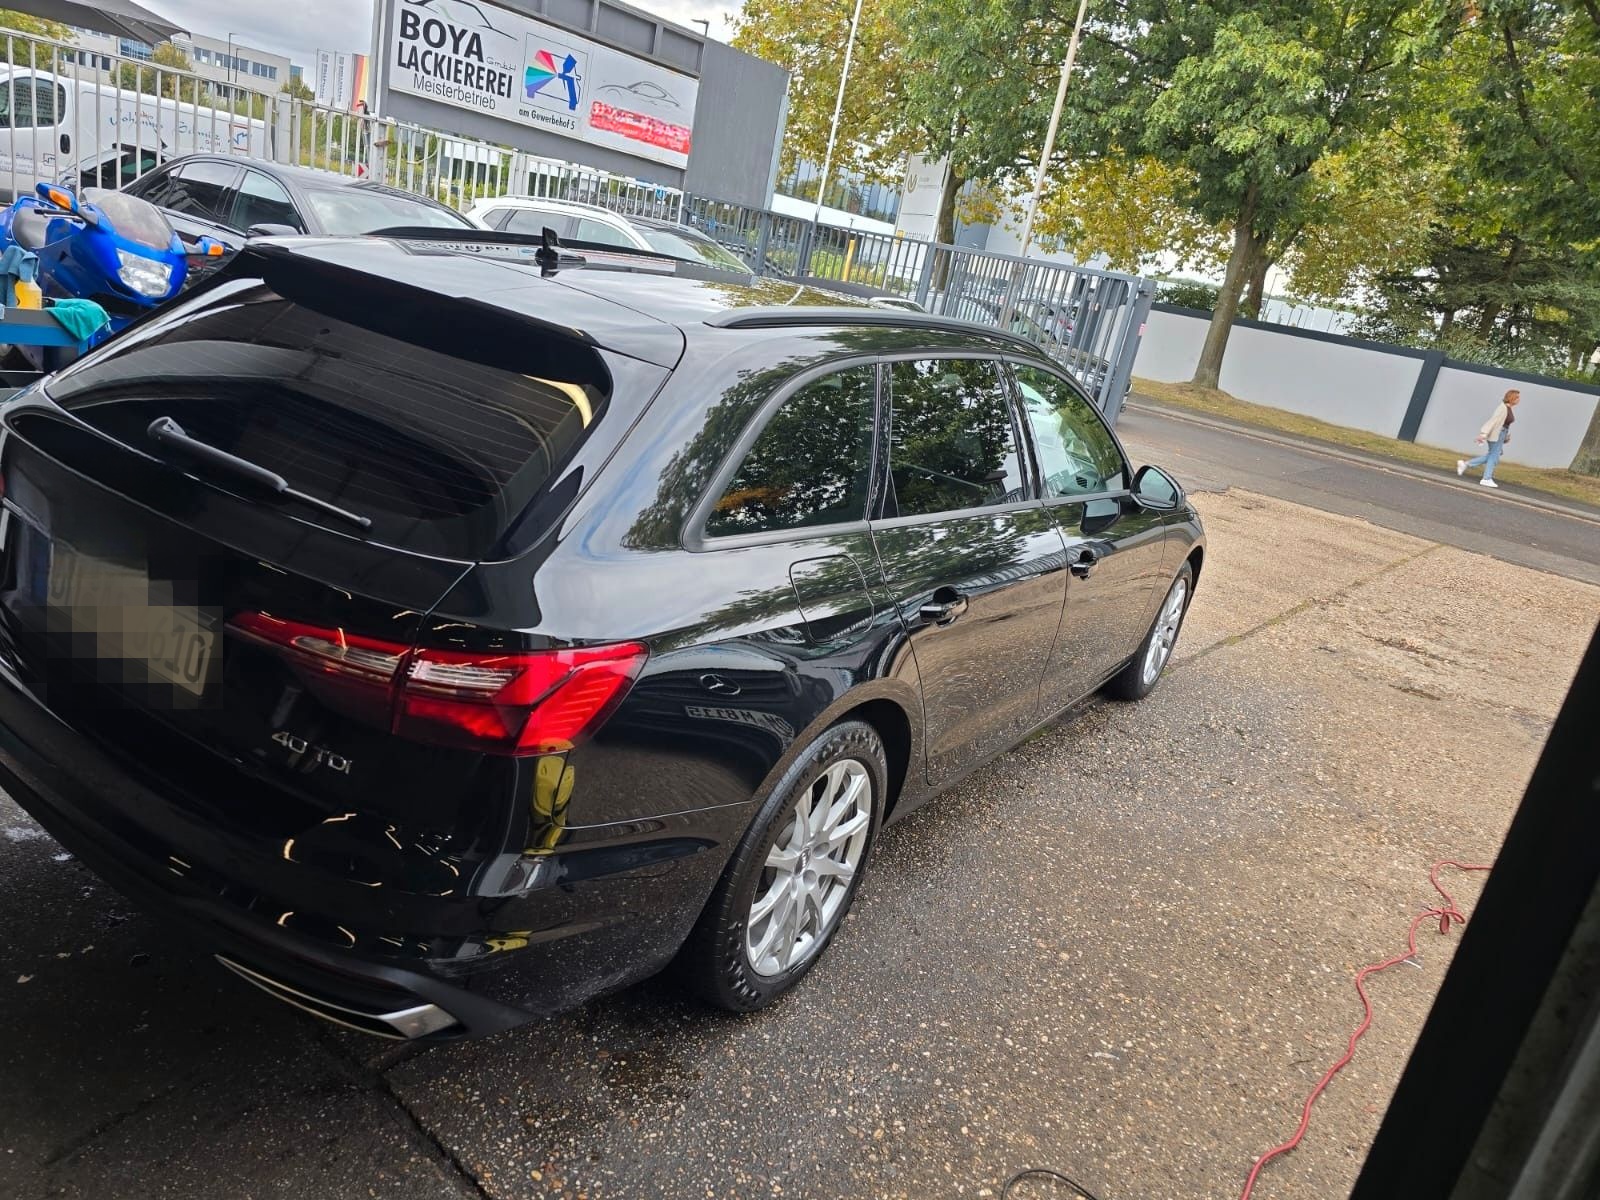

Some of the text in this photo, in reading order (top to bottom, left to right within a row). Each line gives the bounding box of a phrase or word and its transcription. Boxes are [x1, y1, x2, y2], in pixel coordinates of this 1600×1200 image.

[400, 9, 484, 63] BOYA
[397, 41, 513, 98] LACKIEREREI
[413, 73, 496, 110] Meisterbetrieb
[518, 108, 530, 117] am
[531, 110, 570, 129] Gewerbehof
[271, 731, 308, 754] 40
